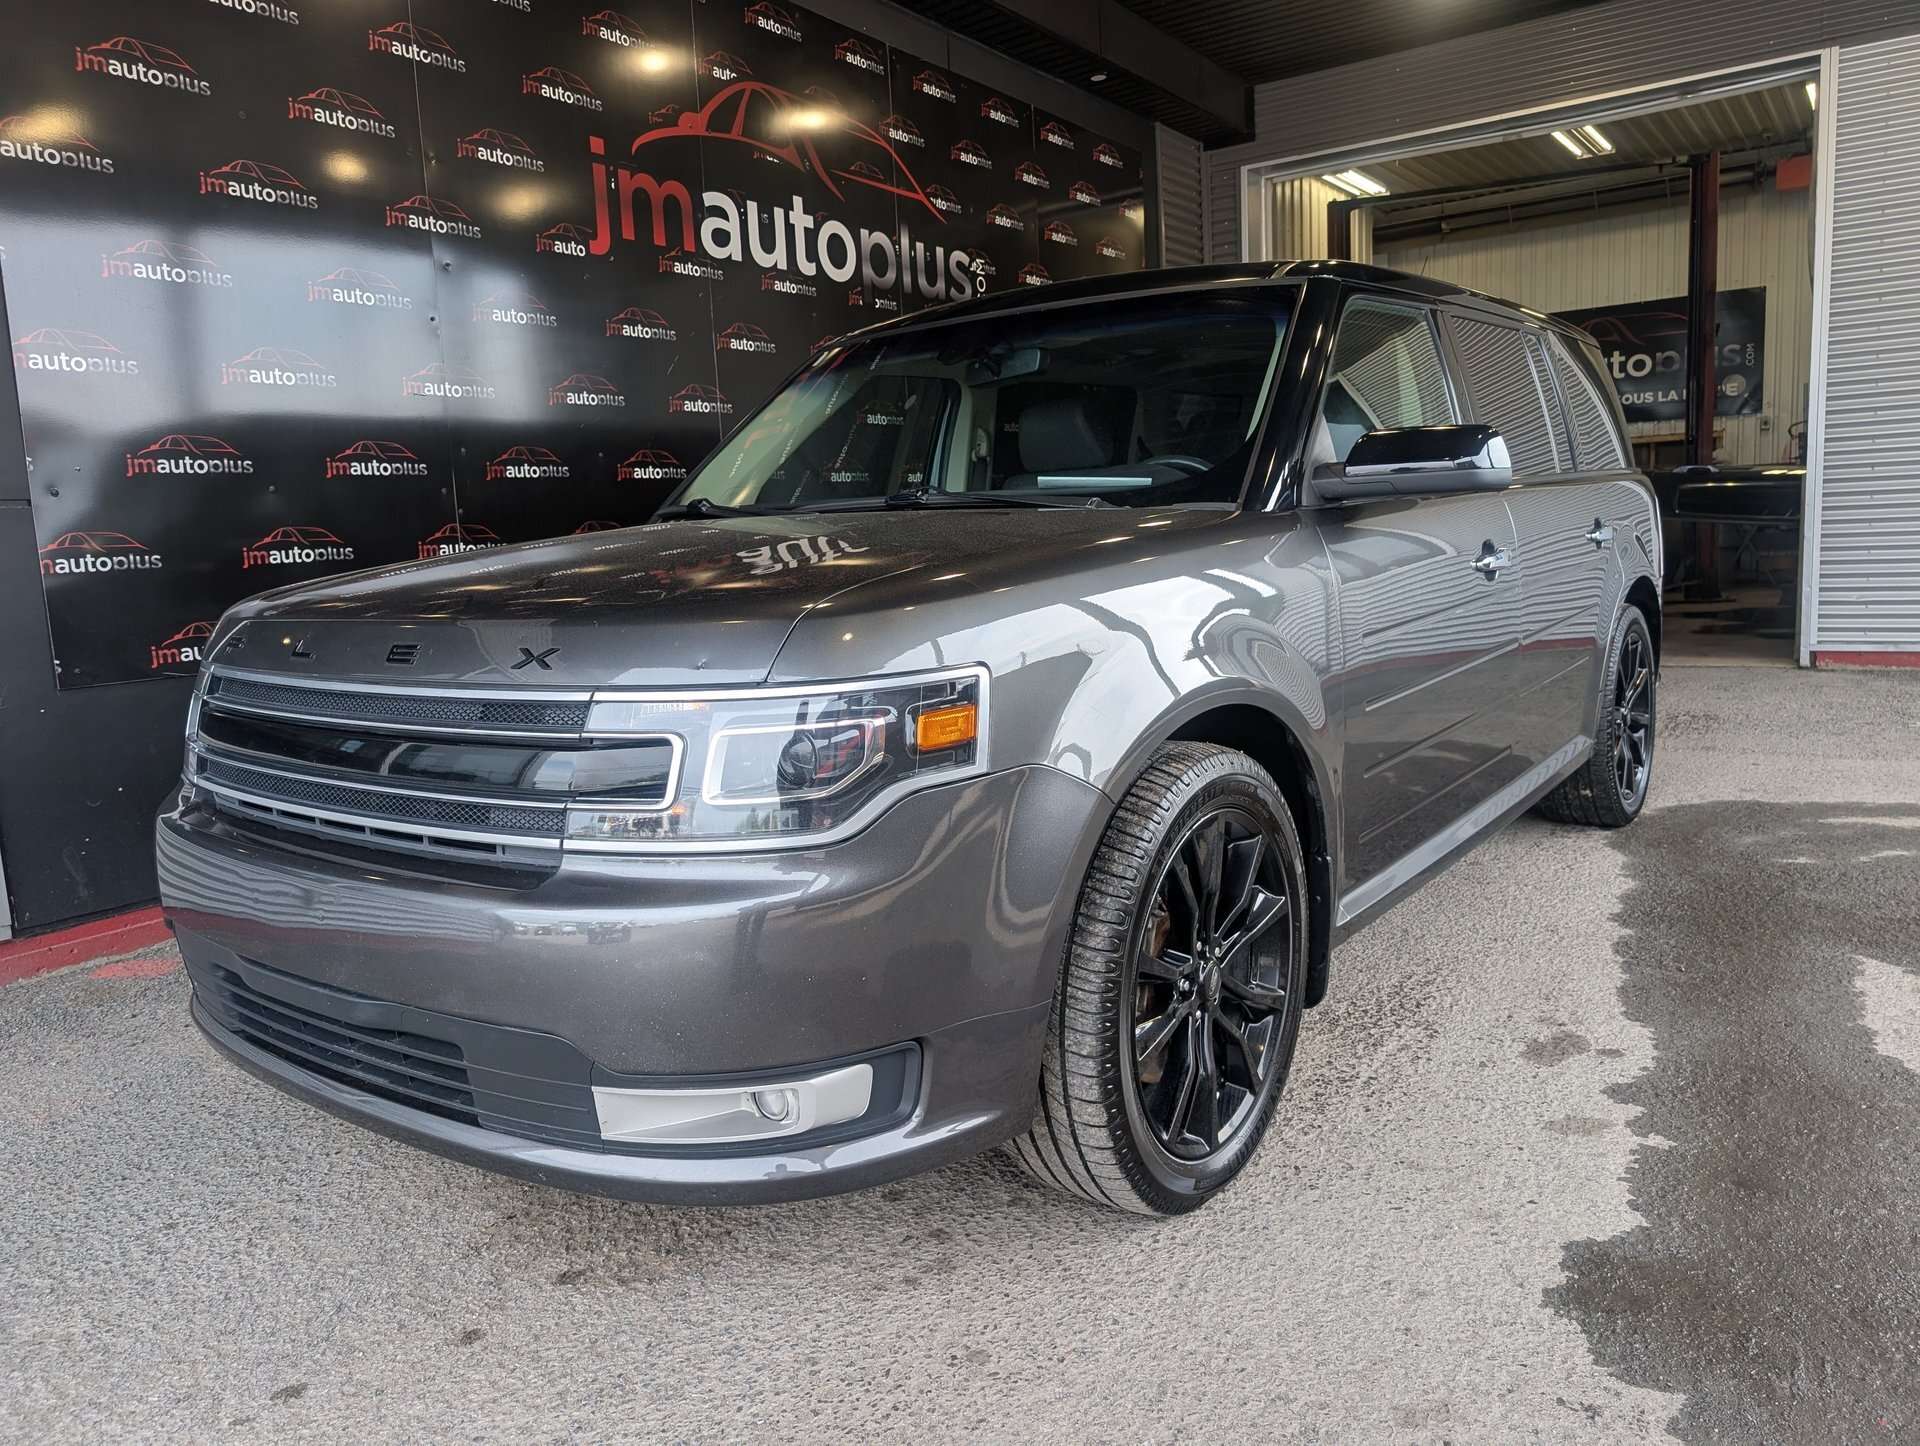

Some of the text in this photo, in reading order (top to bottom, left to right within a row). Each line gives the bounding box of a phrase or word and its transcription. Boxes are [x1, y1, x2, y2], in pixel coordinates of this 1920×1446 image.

[744, 7, 802, 43] jmautoplus
[368, 29, 466, 73] jmautoplus
[834, 45, 884, 76] jmautoplus
[75, 47, 211, 96] jmautoplus
[521, 74, 603, 113] jmautoplus
[288, 97, 396, 139] jmautoplus
[0, 139, 115, 174] autoplus
[457, 137, 545, 173] jmautoplus
[199, 171, 319, 210] jmautoplus
[385, 206, 482, 239] jmautoplus
[588, 135, 973, 303] jmautoplus
[535, 234, 586, 257] jmauto
[101, 254, 233, 288] jmautoplus
[658, 255, 724, 281] jmautoplus
[307, 281, 413, 310] jmautoplus
[760, 274, 817, 297] jmautoplus
[472, 302, 557, 327] jmautoplus
[605, 320, 676, 341] jmautoplus
[716, 334, 776, 354] jmautoplus
[220, 362, 337, 388] jmautoplus
[402, 376, 496, 400] jmautoplus
[549, 387, 625, 407] jmautoplus
[668, 396, 733, 415] jmautoplus
[1618, 391, 1654, 405] OUS
[1658, 389, 1678, 401] LA
[126, 454, 254, 478] jmautoplus
[325, 457, 428, 478] jmautoplus
[486, 462, 570, 481] jmautoplus
[617, 463, 687, 480] jmautoplus
[242, 545, 354, 569] jmautoplus
